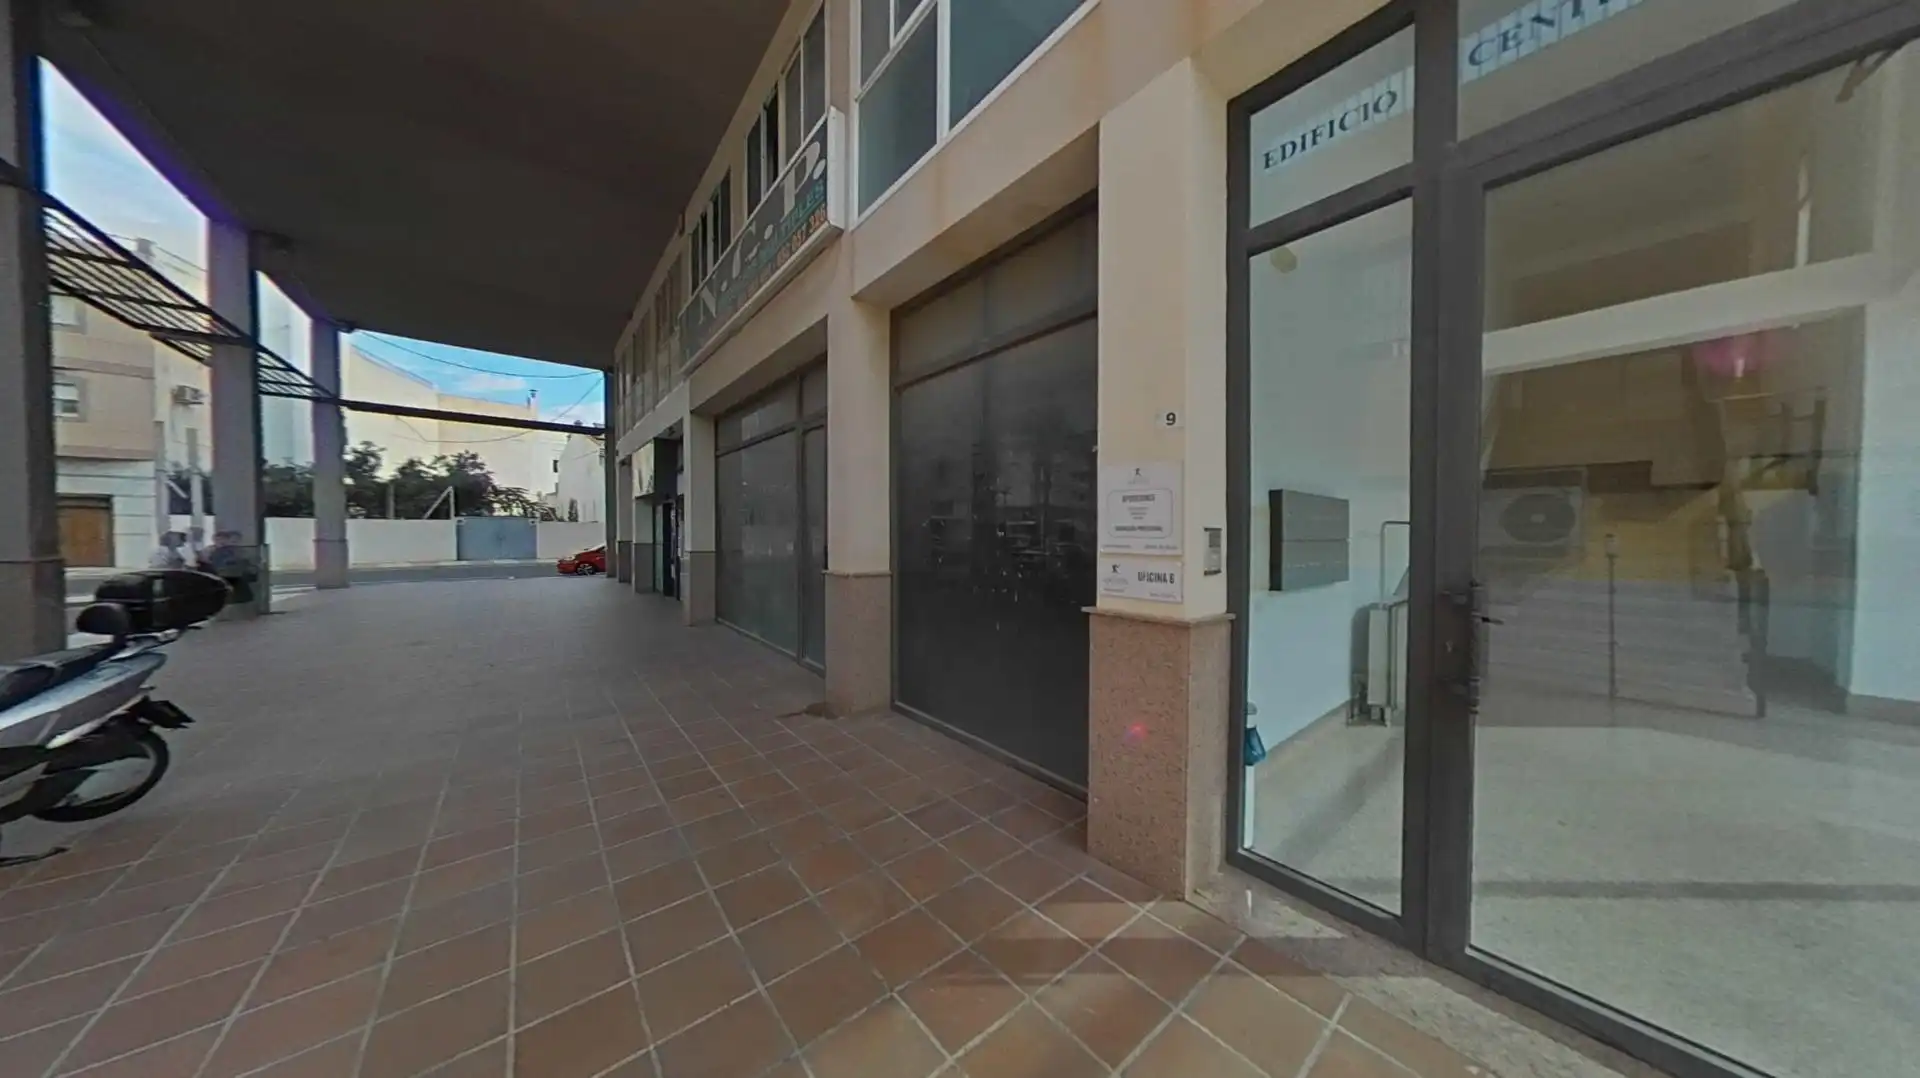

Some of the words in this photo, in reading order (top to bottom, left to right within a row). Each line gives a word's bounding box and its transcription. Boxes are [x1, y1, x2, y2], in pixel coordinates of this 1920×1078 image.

[1262, 89, 1399, 171] EDIFICIO
[1467, 0, 1608, 67] CENT
[1166, 412, 1176, 426] 9
[1137, 571, 1168, 584] OFICINA
